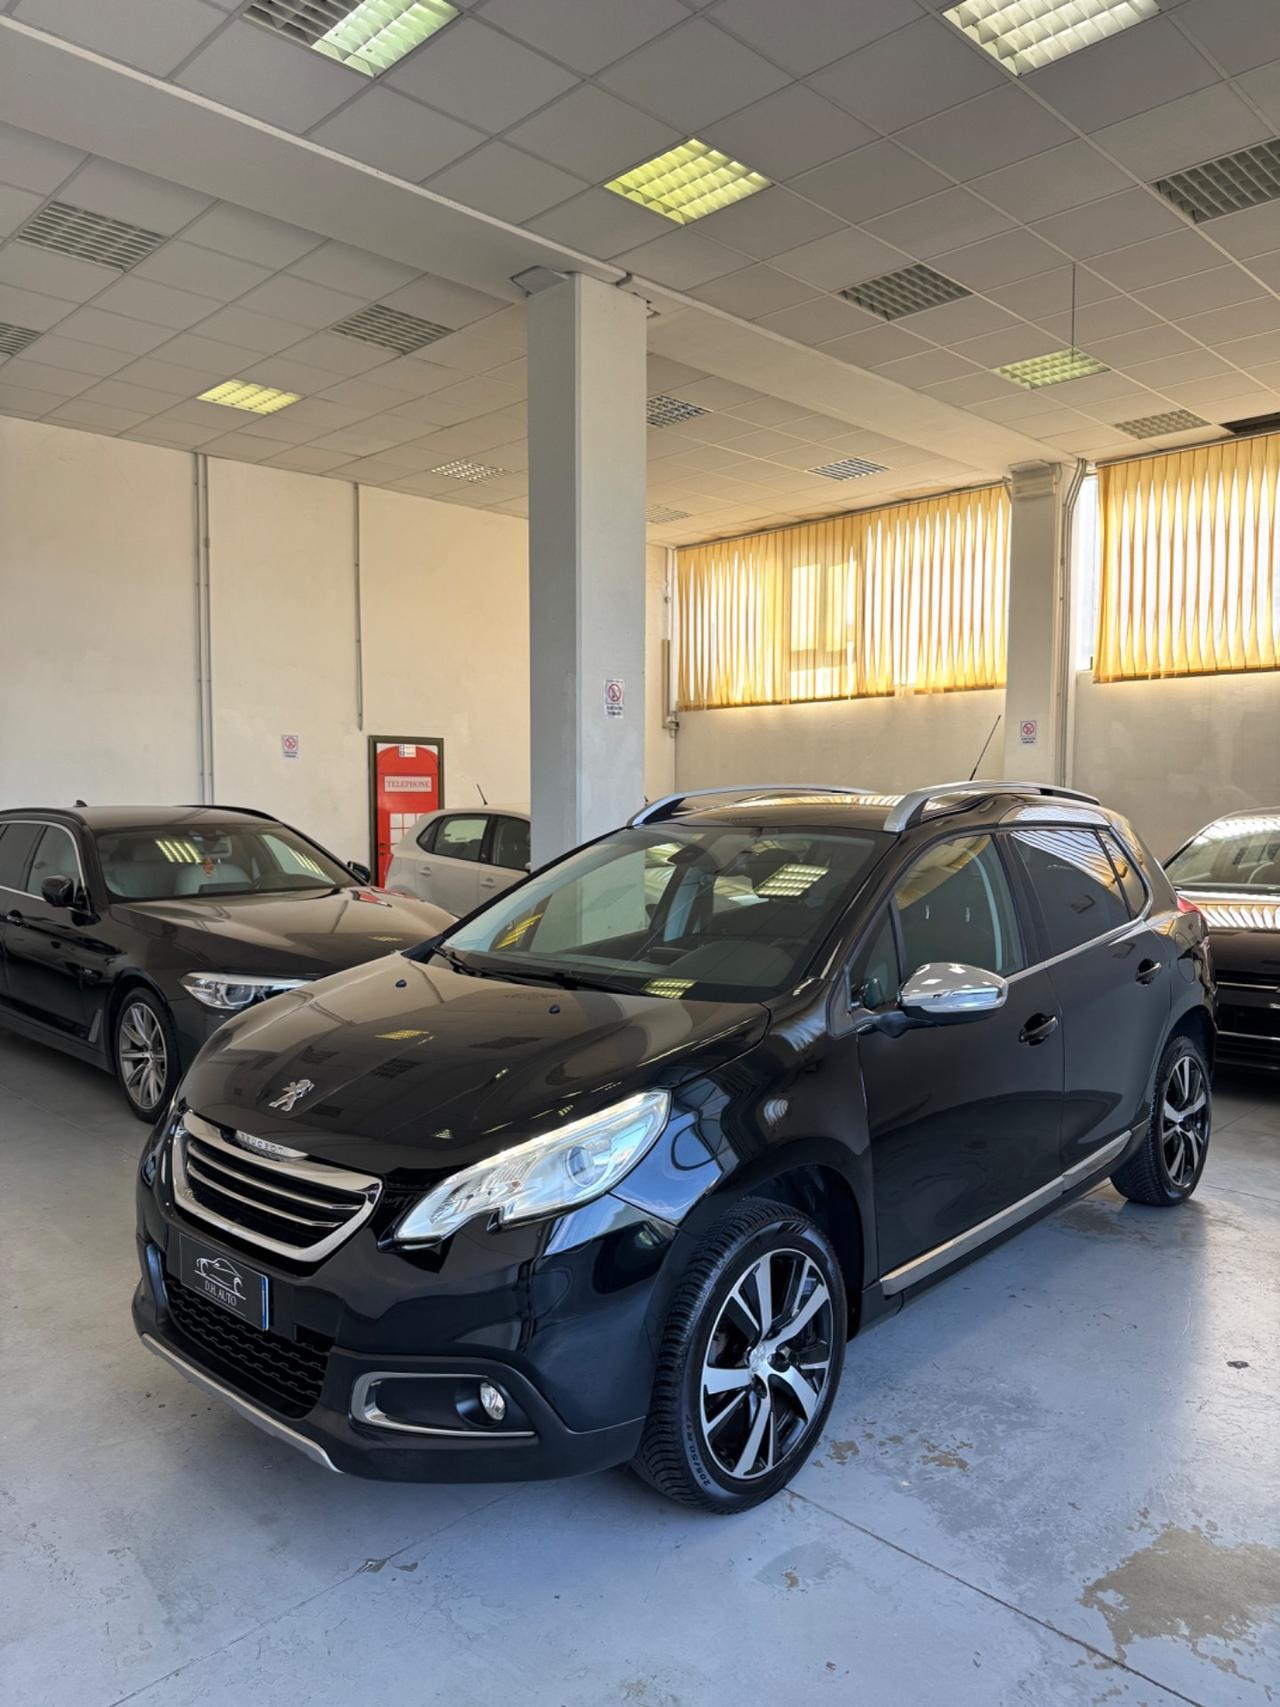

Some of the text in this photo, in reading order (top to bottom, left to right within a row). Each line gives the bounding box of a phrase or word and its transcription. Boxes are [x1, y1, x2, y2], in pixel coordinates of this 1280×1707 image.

[386, 780, 430, 789] TELEPHONE
[240, 1132, 284, 1153] PEUGEOT
[217, 1288, 237, 1307] AUTO
